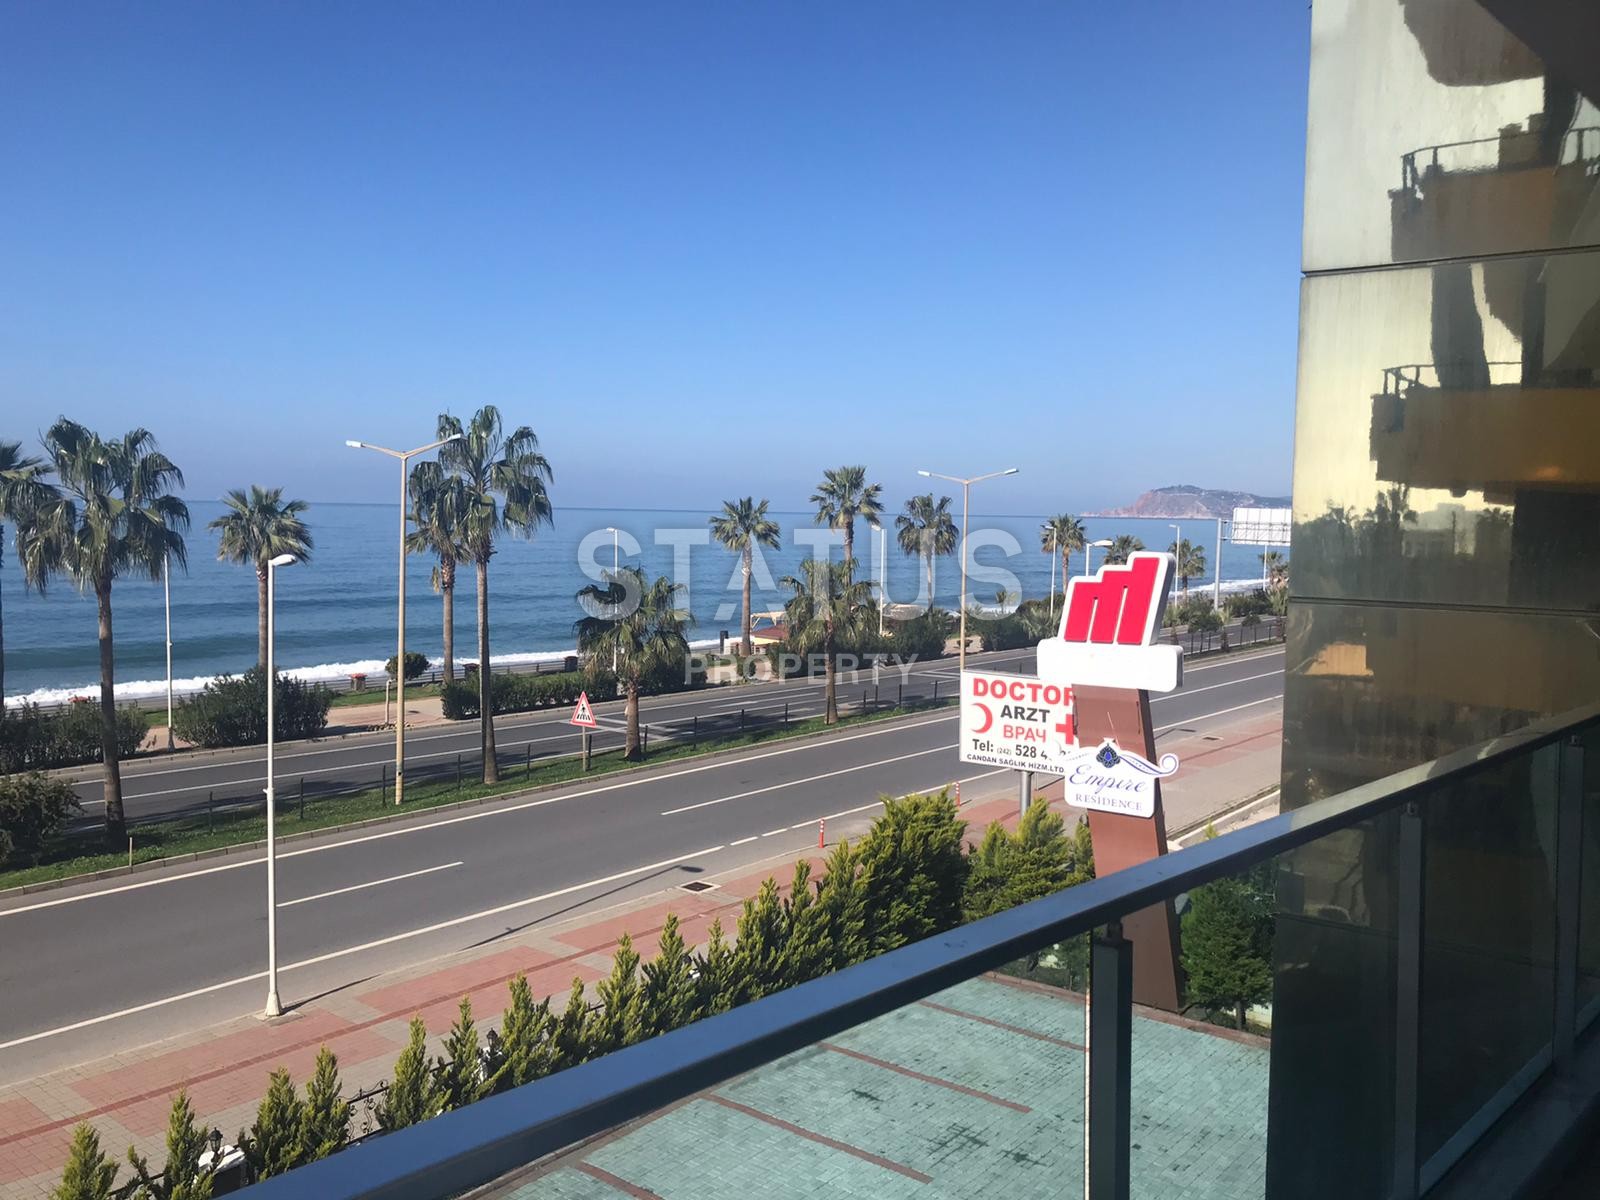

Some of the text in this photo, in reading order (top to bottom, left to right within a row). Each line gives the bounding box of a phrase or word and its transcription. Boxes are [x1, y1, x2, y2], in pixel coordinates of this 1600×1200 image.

[1000, 705, 1051, 723] ARZT
[1003, 725, 1046, 743] ВРАЧ
[972, 738, 994, 752] Tel:
[1015, 744, 1037, 758] 528
[967, 753, 997, 763] CANDAN
[999, 757, 1026, 768] SAĞLIK
[1069, 764, 1147, 794] Empire
